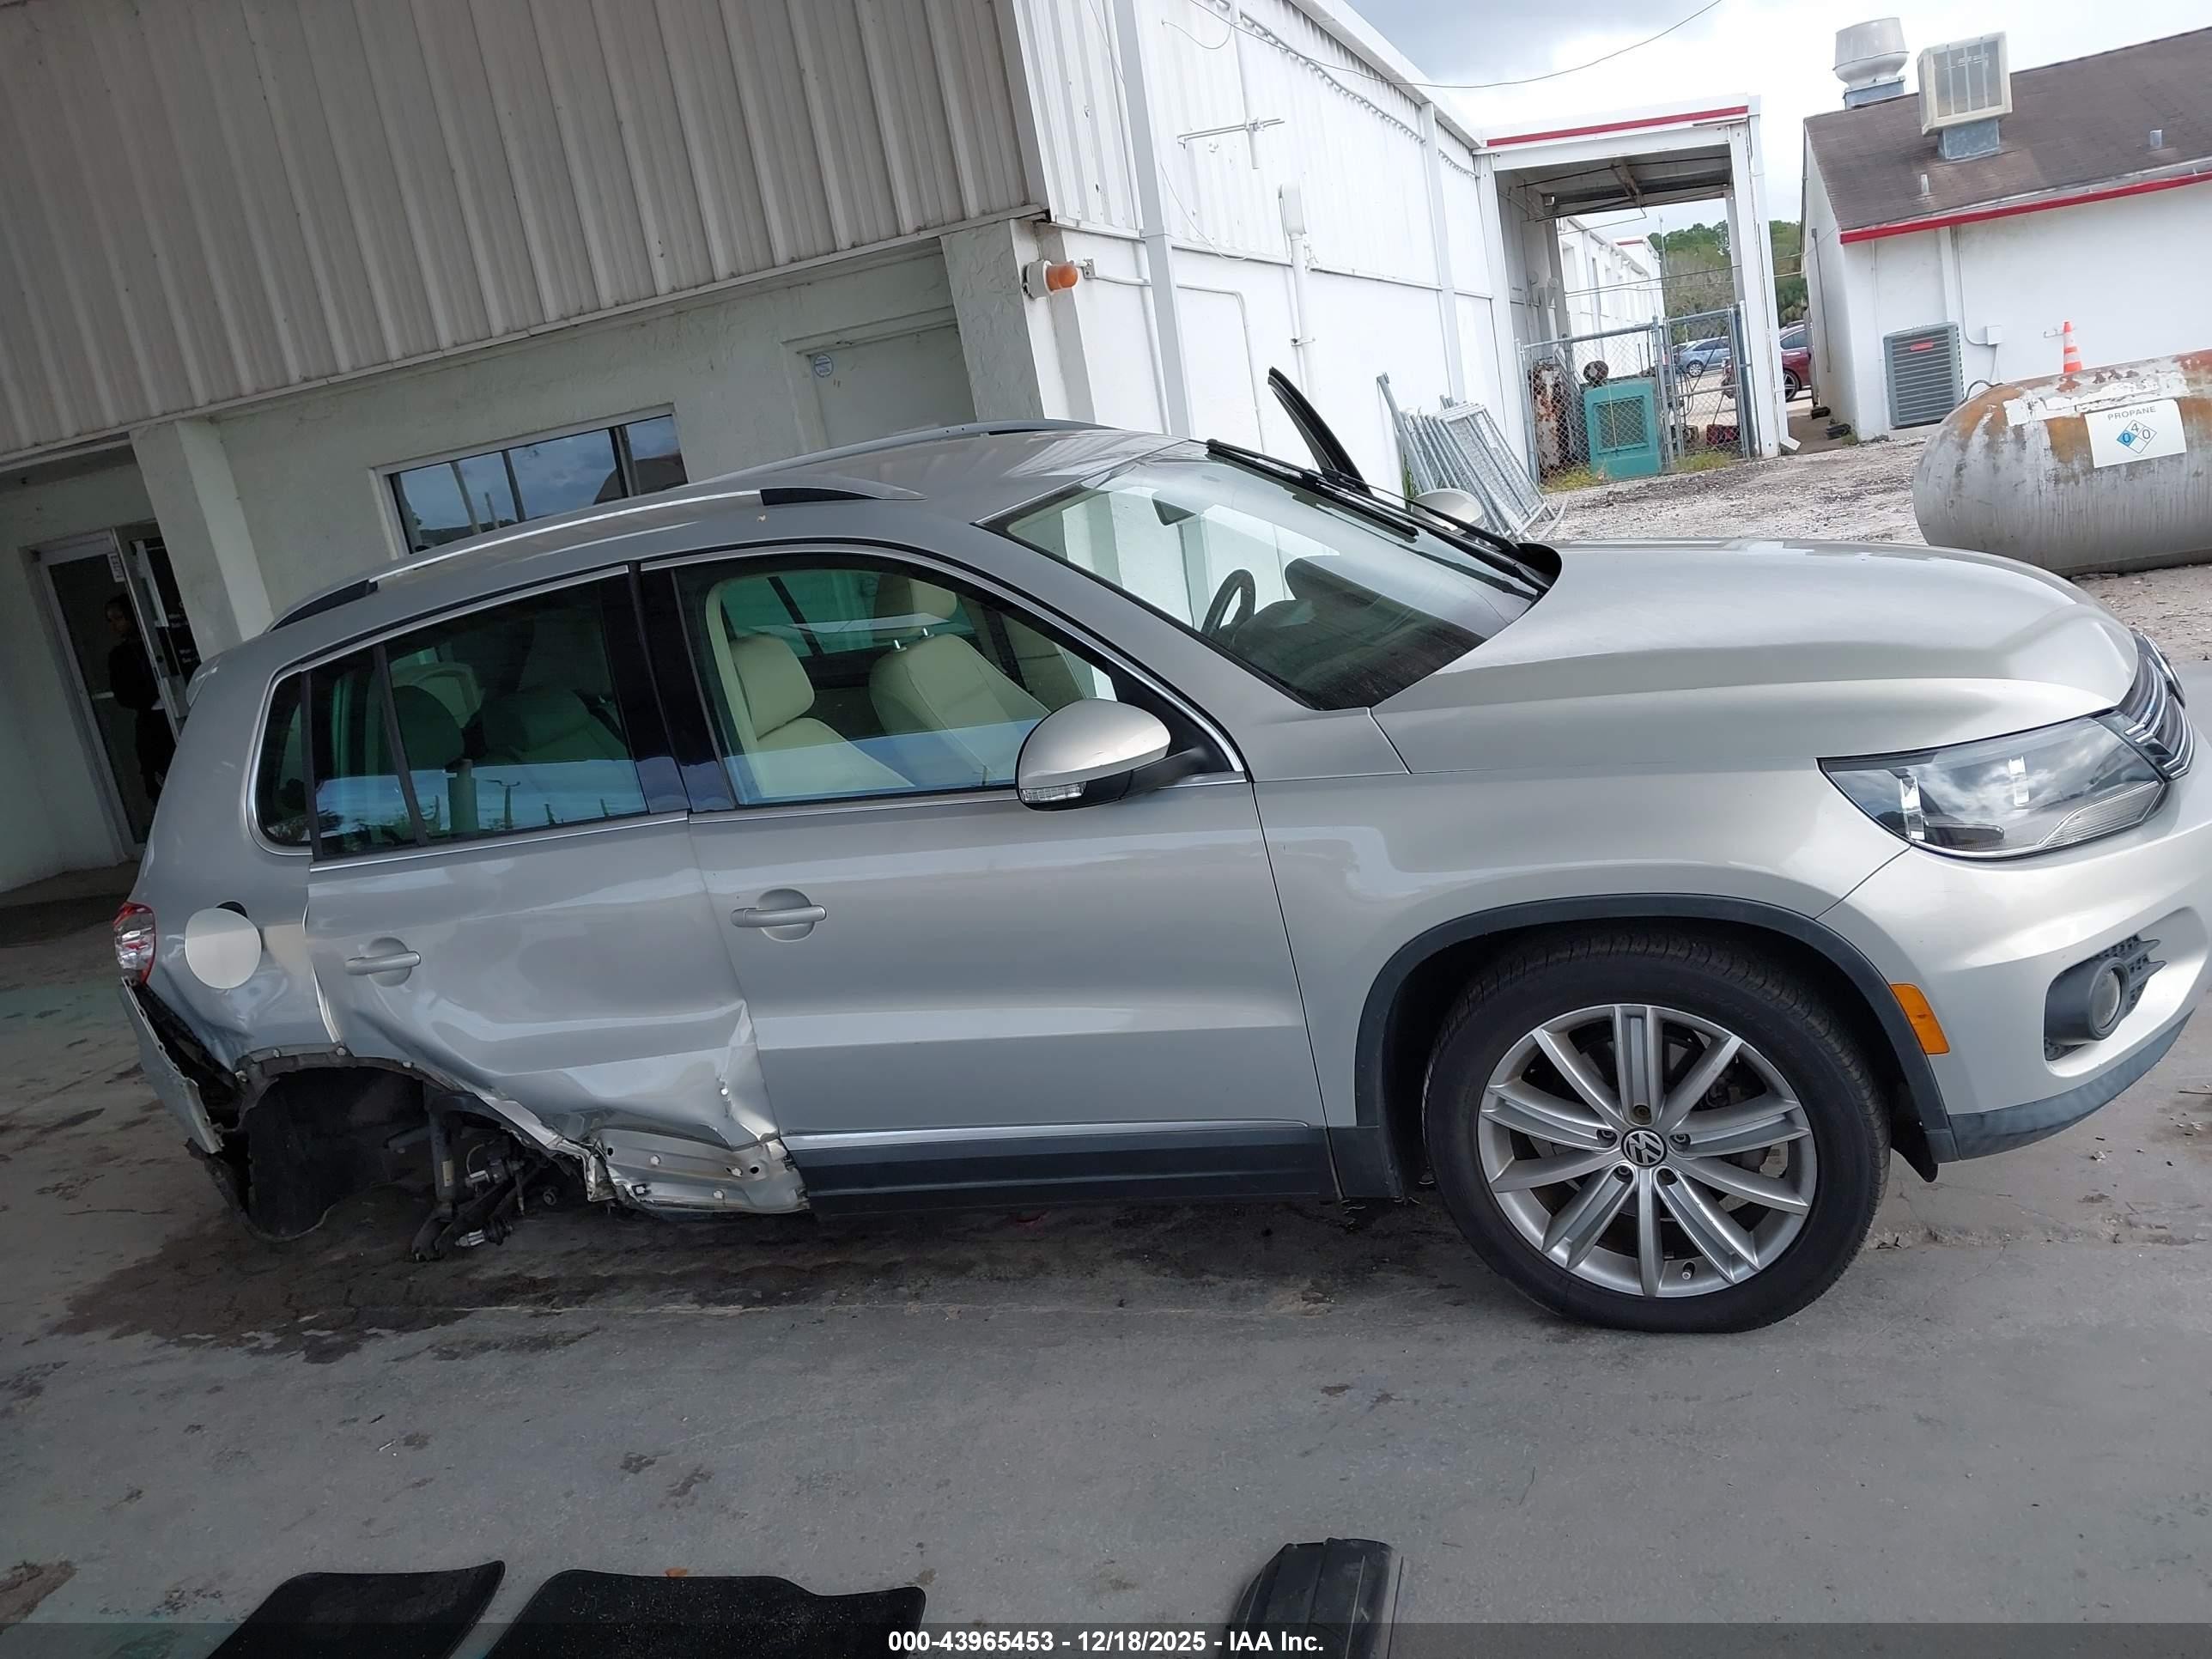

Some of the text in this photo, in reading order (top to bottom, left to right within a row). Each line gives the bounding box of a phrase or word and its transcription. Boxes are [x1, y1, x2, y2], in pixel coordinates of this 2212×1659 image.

[2107, 406, 2156, 420] PROPANE
[2130, 422, 2140, 432] 4
[2122, 432, 2130, 443] 0
[2142, 428, 2151, 440] 0
